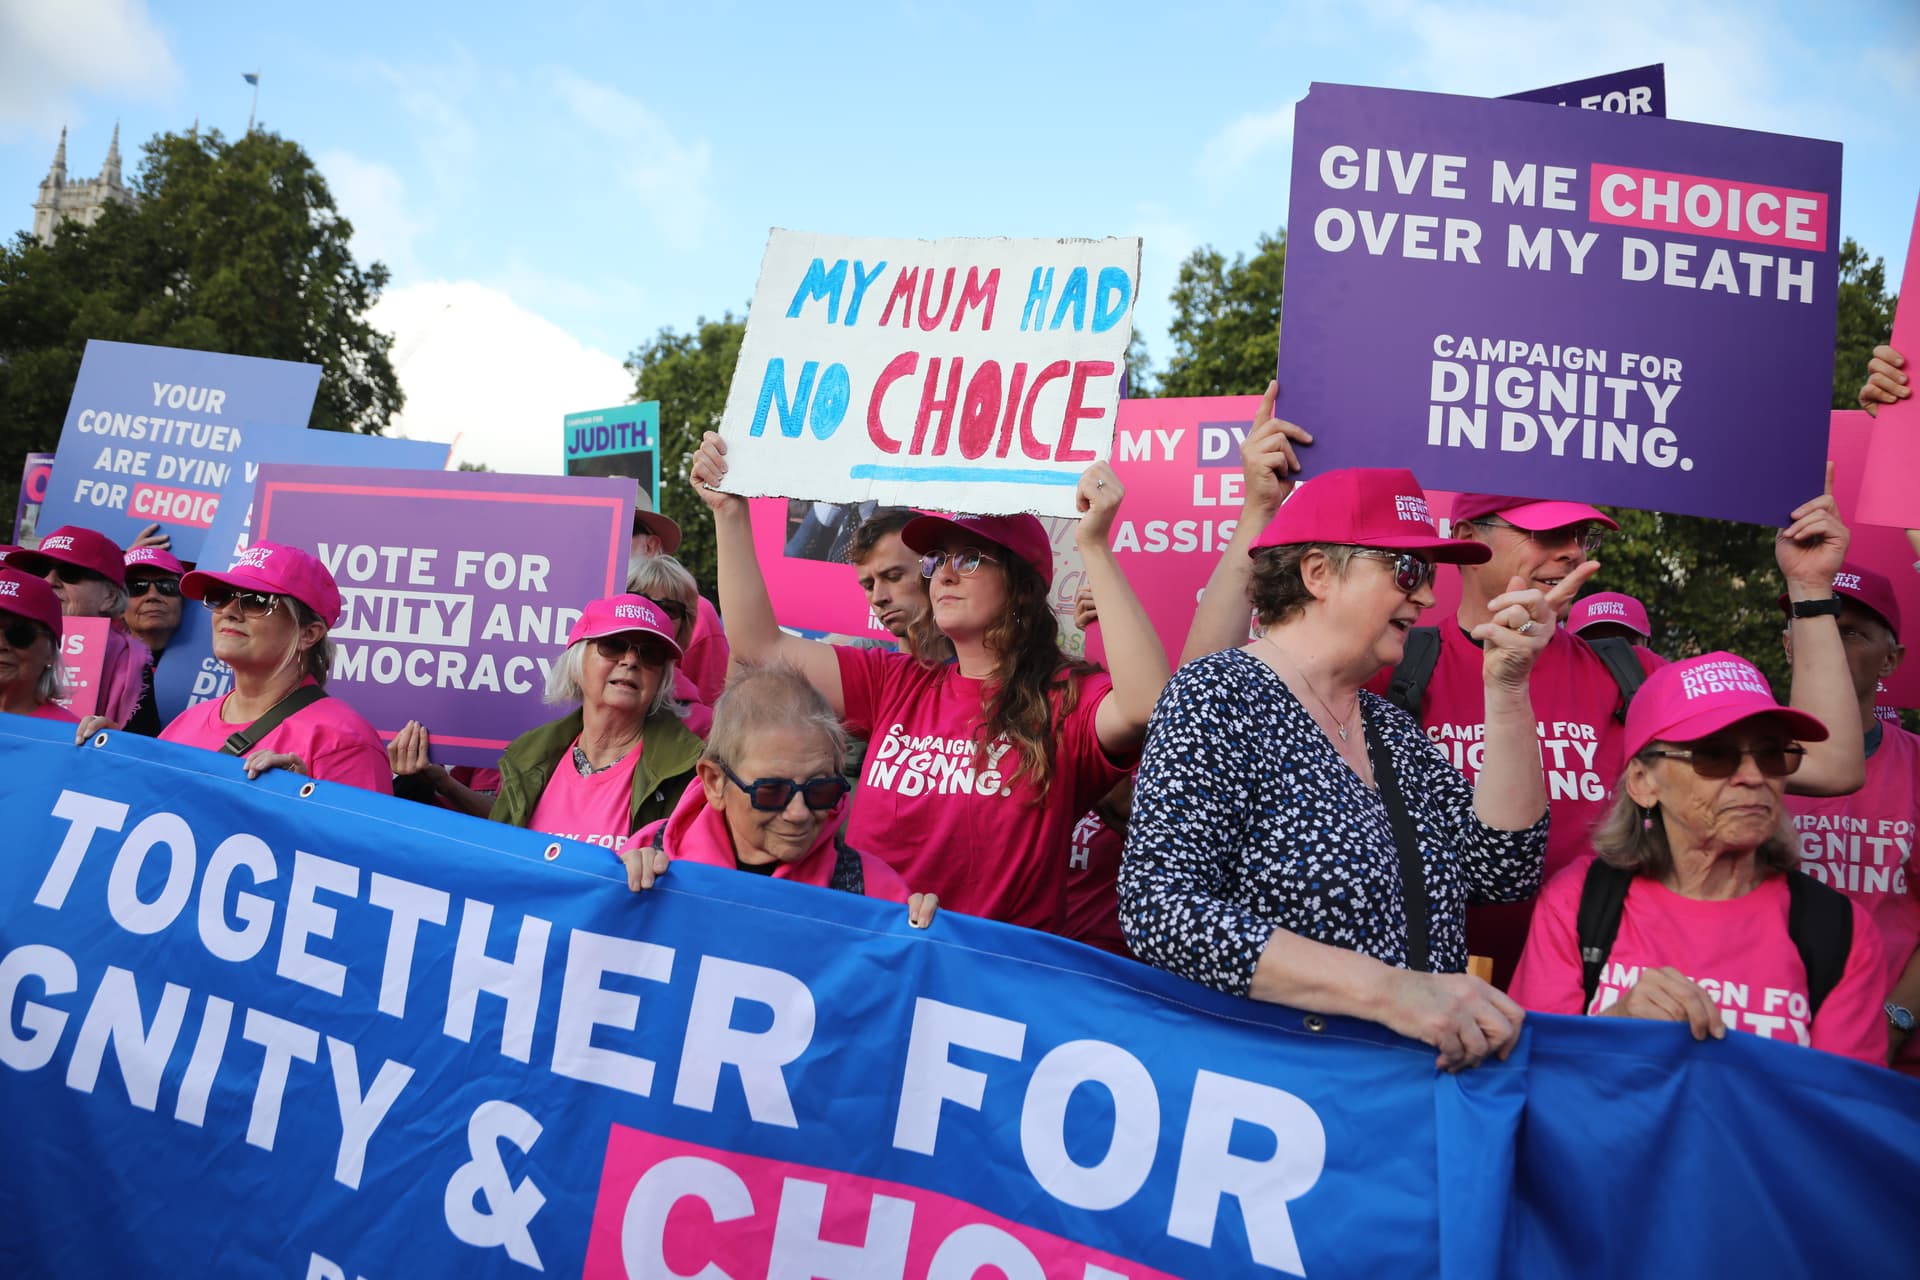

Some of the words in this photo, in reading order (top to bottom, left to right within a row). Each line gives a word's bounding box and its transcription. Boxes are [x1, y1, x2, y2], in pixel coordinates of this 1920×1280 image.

[1319, 144, 1467, 199] GIVE
[1491, 160, 1577, 212] ME
[1600, 173, 1818, 243] CHOICE
[1314, 207, 1482, 264] OVER
[1507, 224, 1599, 275] MY
[1622, 237, 1814, 304] DEATH
[786, 257, 888, 327] MY
[878, 265, 1001, 333] MUM
[1019, 265, 1130, 333] HAD
[1432, 333, 1607, 373] CAMPAIGN
[1620, 351, 1684, 382] FOR
[151, 381, 227, 415] YOUR
[749, 356, 850, 440] NO
[867, 351, 1115, 463] CHOICE
[1430, 359, 1682, 425] DIGNITY
[1119, 428, 1186, 463] MY
[1427, 404, 1487, 450] IN
[1500, 411, 1694, 471] DYING.
[93, 446, 148, 477] ARE
[156, 454, 231, 488] DYIN
[74, 478, 129, 510] FOR
[317, 542, 438, 586] VOTE
[454, 550, 551, 593] FOR
[1680, 661, 1738, 678] CAMPAIGN
[1683, 668, 1761, 689] DIGNITY
[1685, 684, 1708, 700] IN
[1552, 721, 1598, 741] FOR
[866, 760, 900, 790] IN
[33, 789, 815, 1129] TOGETHER
[892, 997, 1326, 1278] FOR
[444, 1100, 546, 1272] &
